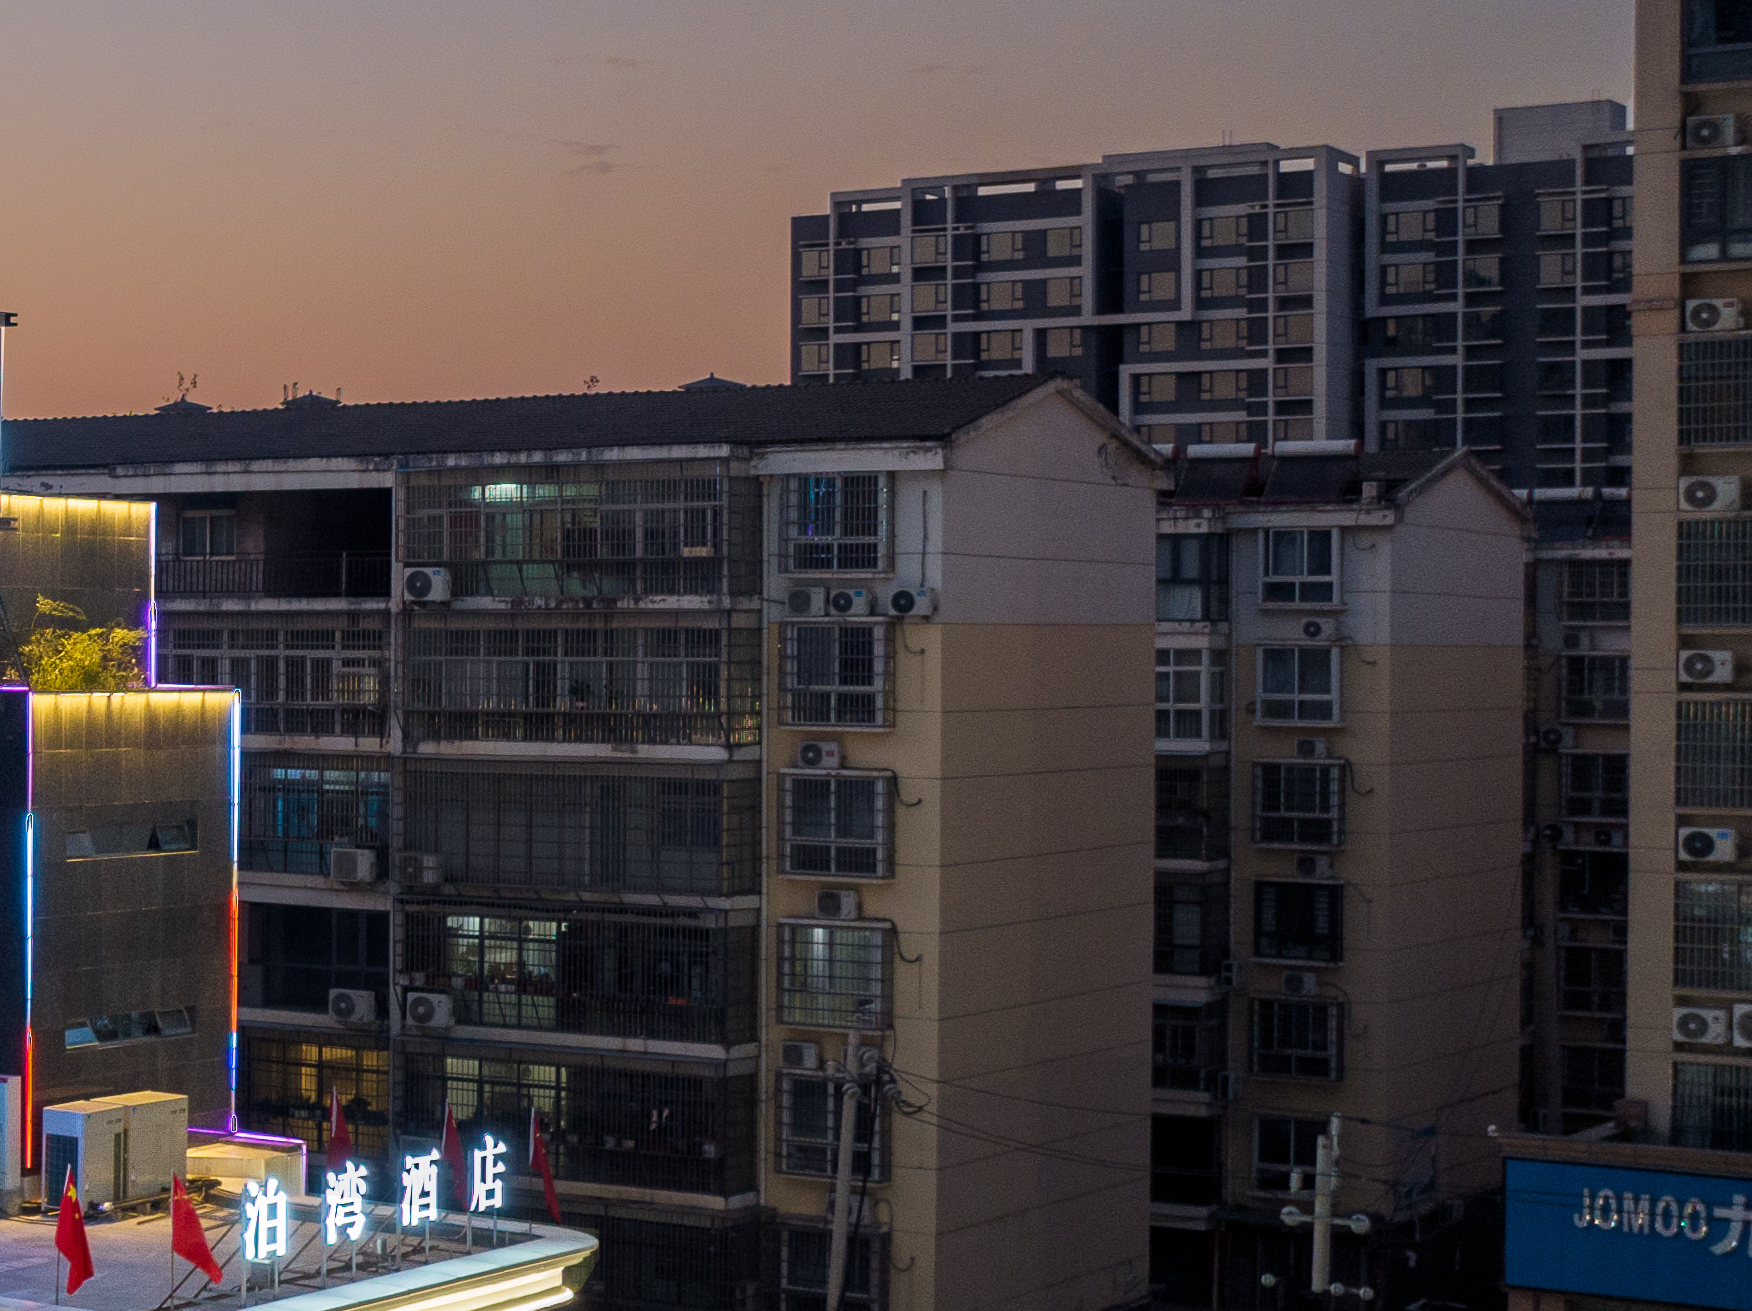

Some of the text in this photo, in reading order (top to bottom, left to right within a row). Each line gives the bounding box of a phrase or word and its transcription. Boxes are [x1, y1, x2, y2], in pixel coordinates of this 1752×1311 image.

[242, 1133, 507, 1261] 泊湾酒店
[1573, 1186, 1710, 1241] JOMOO
